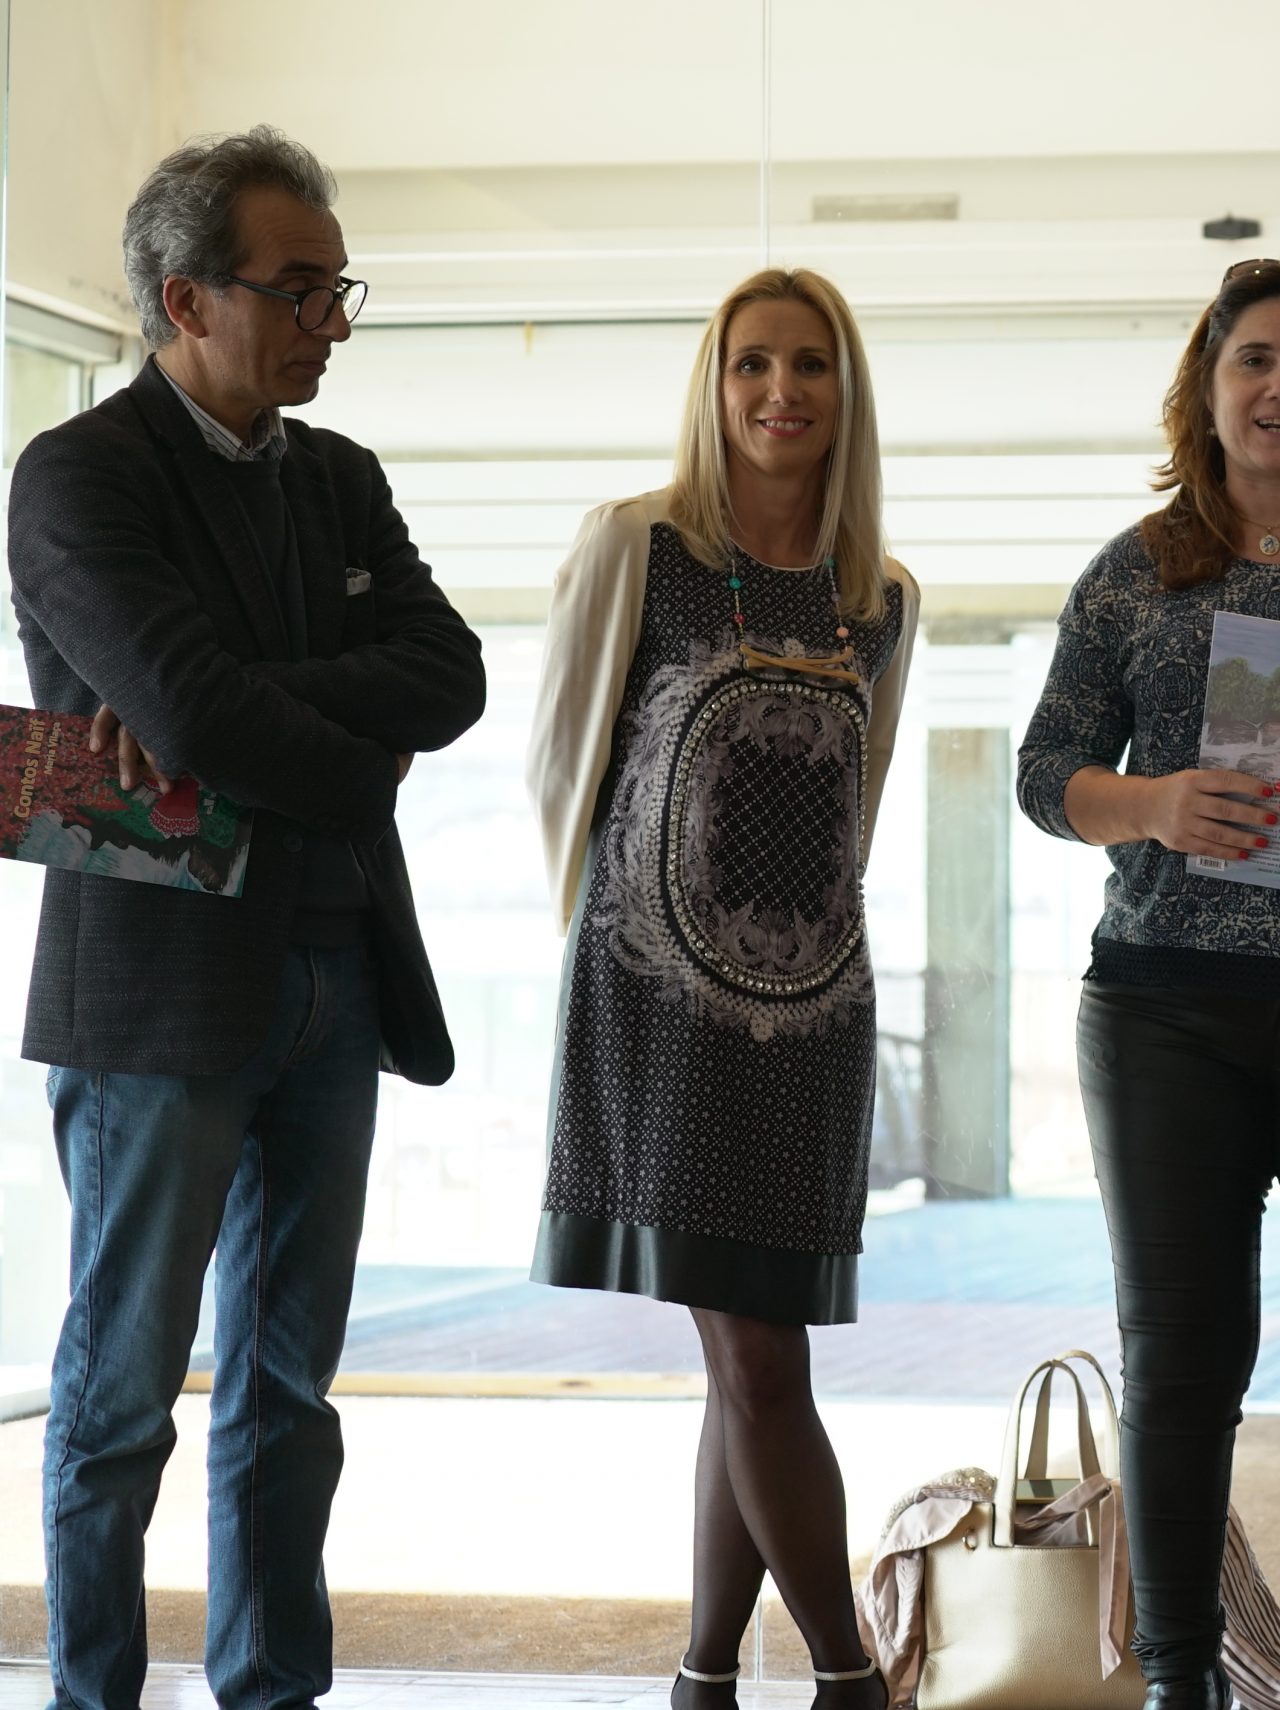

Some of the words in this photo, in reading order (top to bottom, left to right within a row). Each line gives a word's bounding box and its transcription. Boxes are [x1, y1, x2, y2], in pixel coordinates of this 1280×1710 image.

[24, 718, 46, 755] Naïf
[48, 721, 62, 748] Vilaça
[43, 750, 56, 775] Maria
[13, 758, 39, 818] Contos
